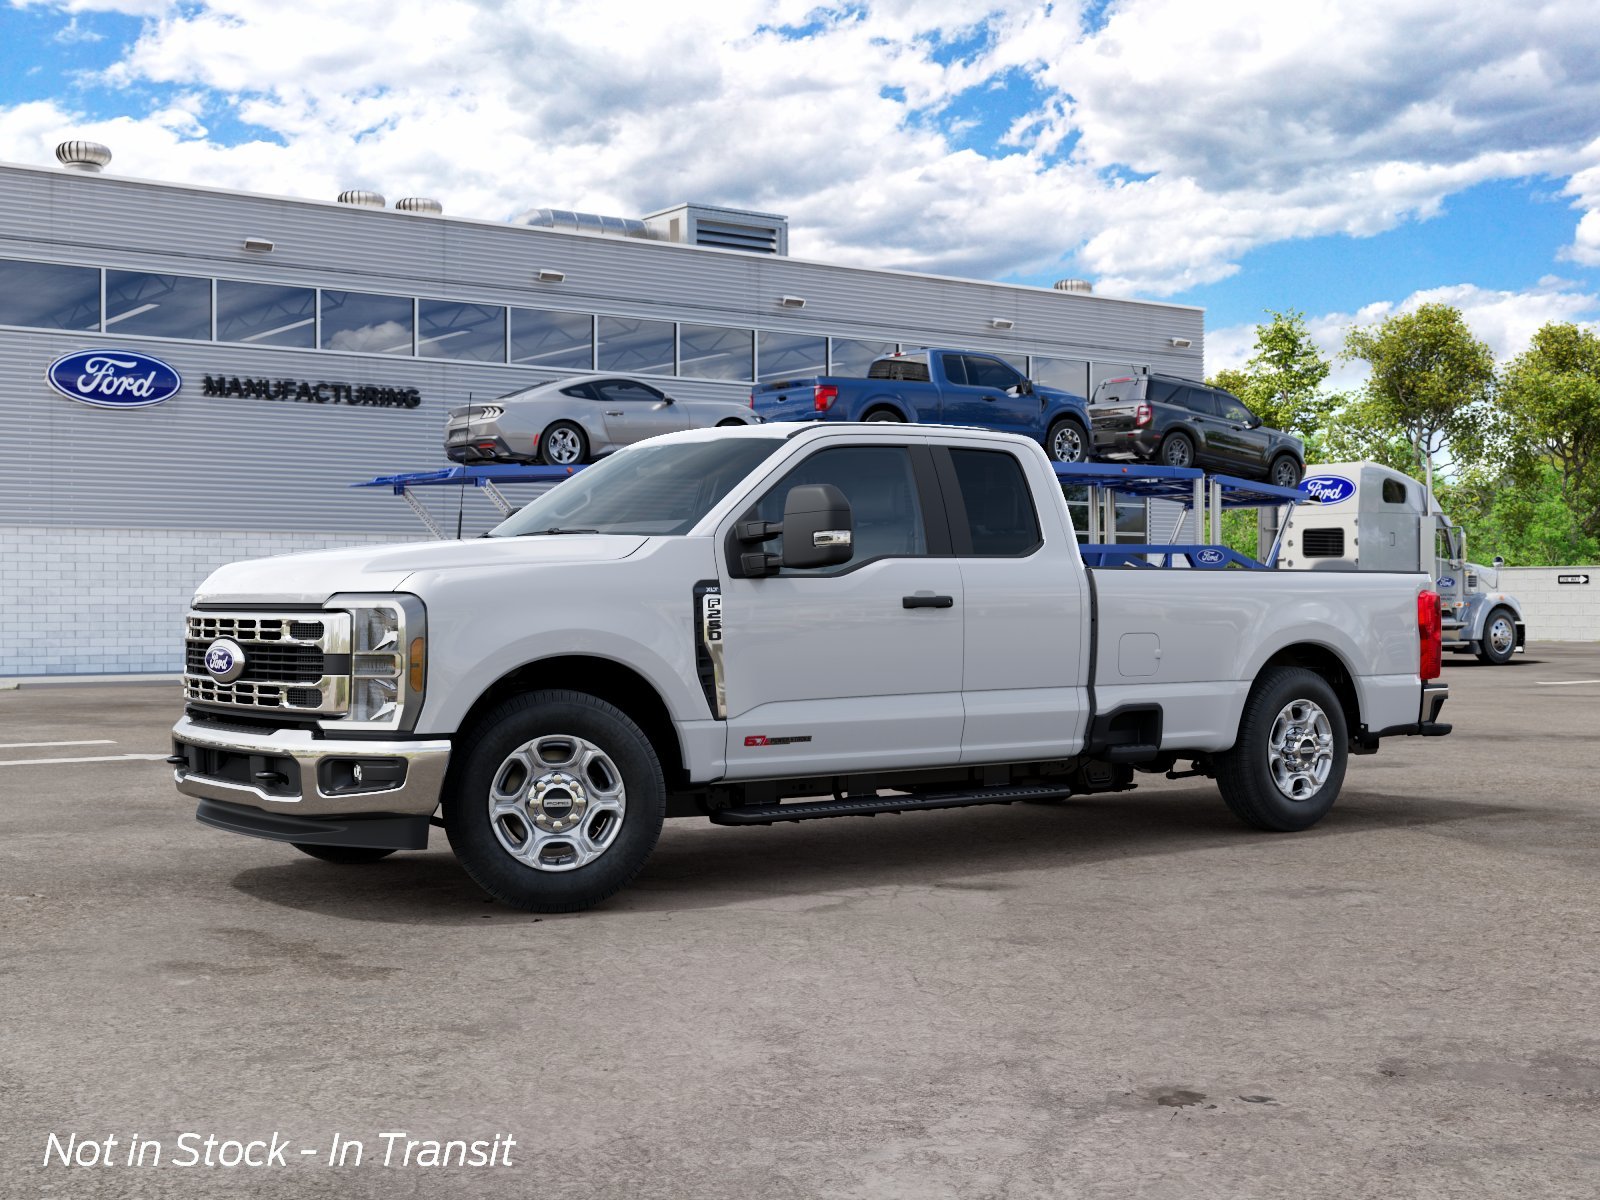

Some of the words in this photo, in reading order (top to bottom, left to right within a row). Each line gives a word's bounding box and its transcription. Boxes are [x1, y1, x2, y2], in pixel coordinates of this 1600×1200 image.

[77, 357, 157, 397] Ford
[203, 373, 421, 408] MANUFACTURING
[1306, 480, 1343, 499] Ford
[209, 650, 229, 670] Ford
